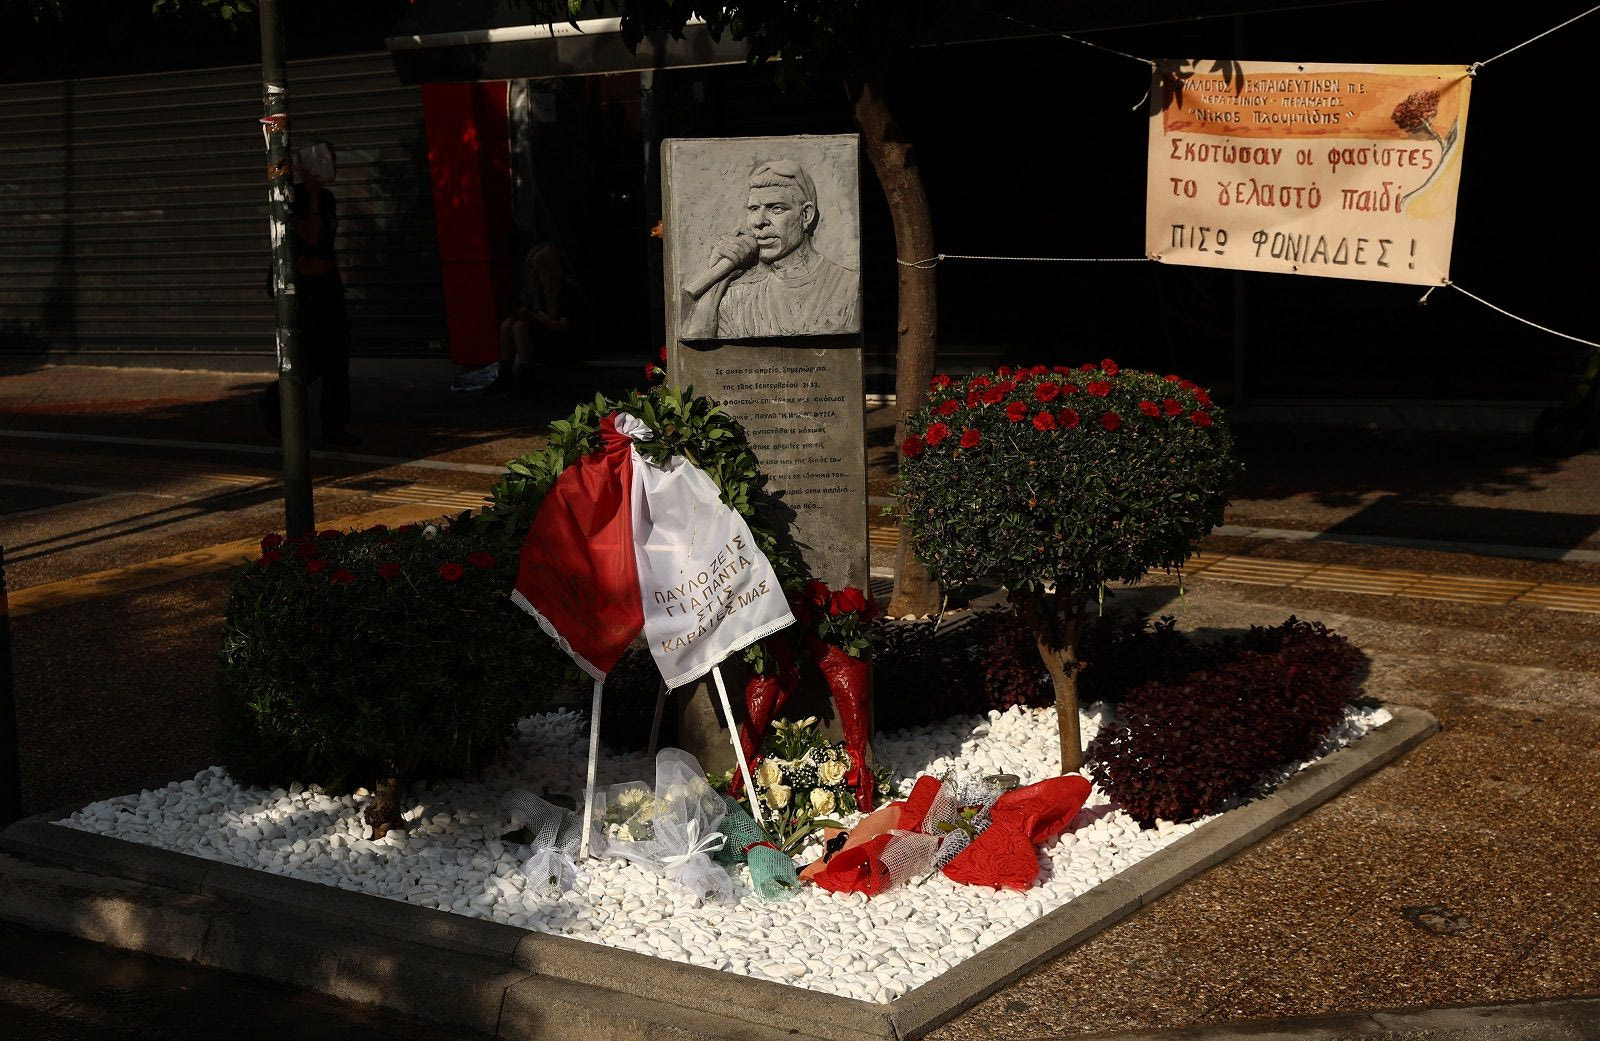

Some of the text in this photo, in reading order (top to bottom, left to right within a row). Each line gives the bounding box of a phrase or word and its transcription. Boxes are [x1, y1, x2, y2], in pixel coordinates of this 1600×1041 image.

[1182, 79, 1231, 93] ΥΛΛΟΓΟΣ
[1245, 78, 1340, 94] ΕΚΠΑΙΔΕΥΤΙΚΩΝ
[1281, 95, 1344, 107] ΠΕΡΑΜΑΤΟΣ
[1170, 137, 1434, 174] Σκοτώσαν οι φασίστες
[1170, 177, 1402, 214] το γελαστό παιδί
[1170, 224, 1228, 255] ΠΙΣΩ
[654, 534, 746, 605] ΠΑΥΛΟ ΖΕΙΣ
[665, 555, 751, 618] ΓΙΑ ΠΑΝΤΑ
[661, 579, 771, 654] ΚΑΡΔΙΕΣ ΜΑΣ
[696, 585, 736, 623] ΣΤΙΣ
